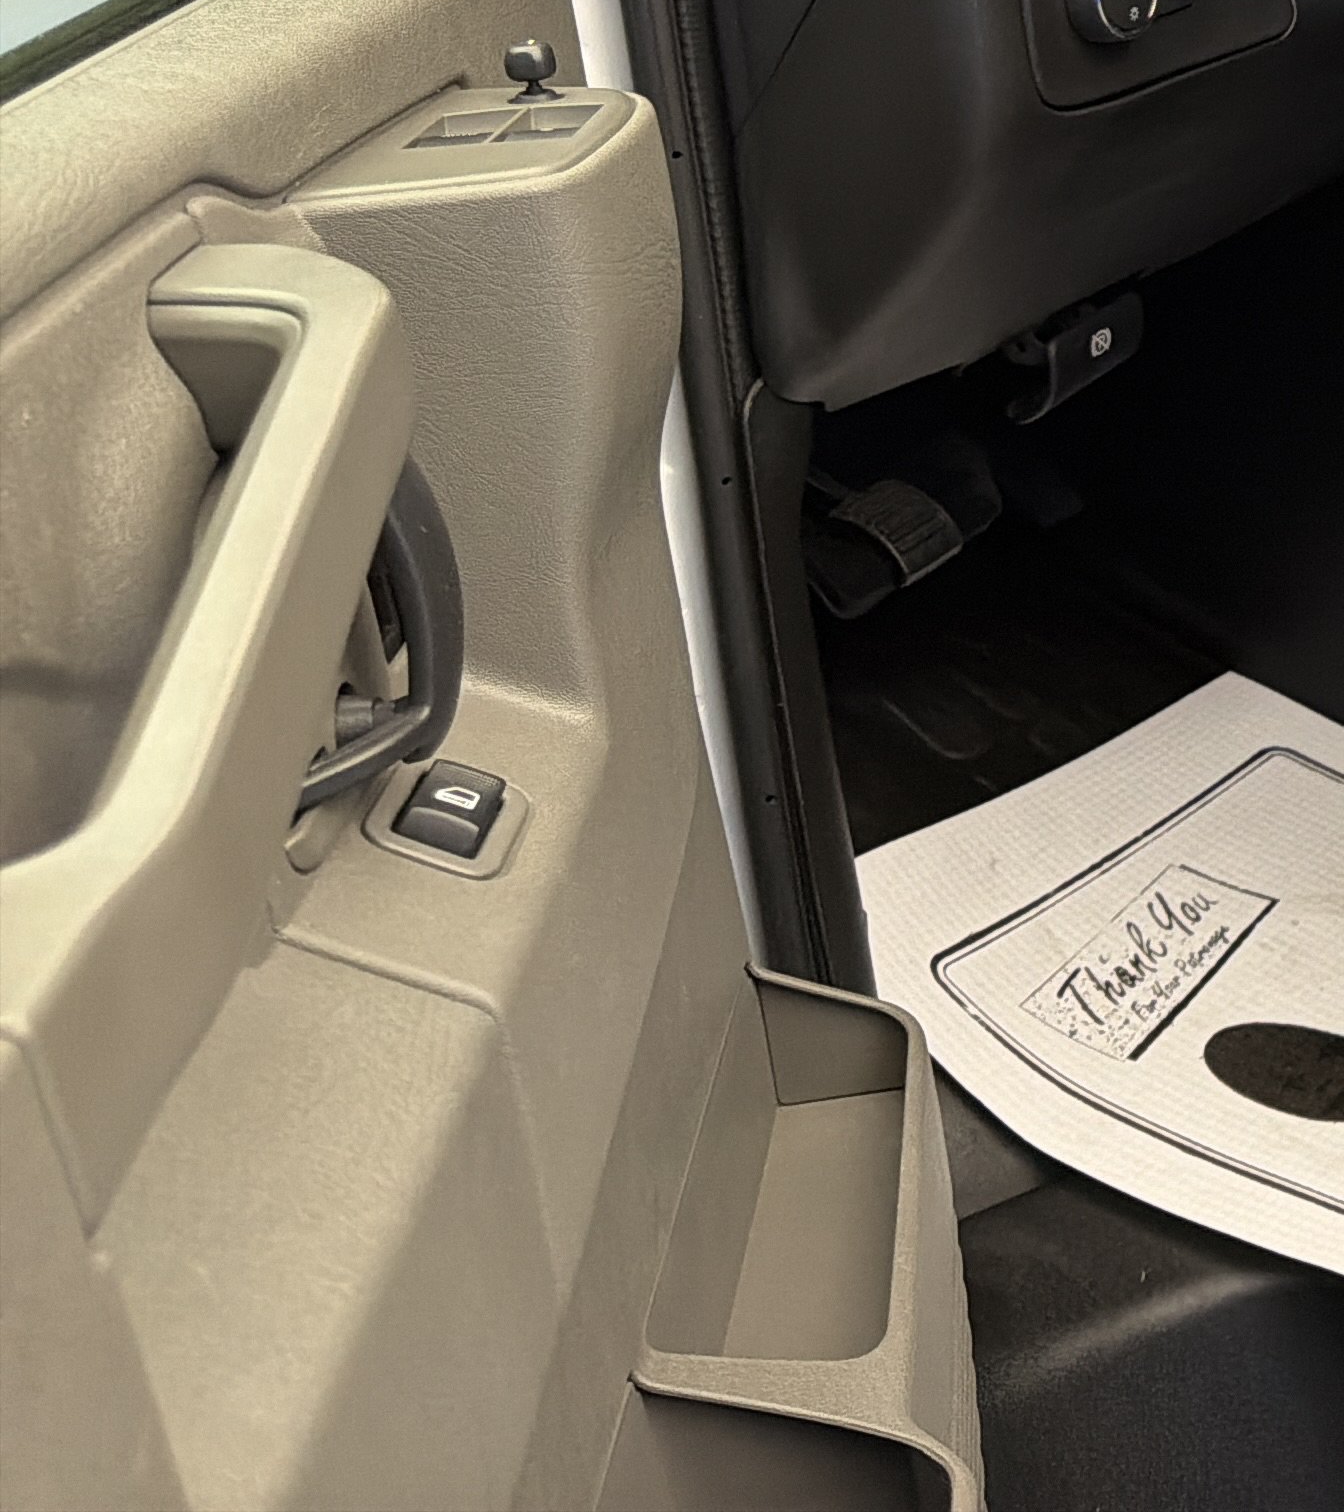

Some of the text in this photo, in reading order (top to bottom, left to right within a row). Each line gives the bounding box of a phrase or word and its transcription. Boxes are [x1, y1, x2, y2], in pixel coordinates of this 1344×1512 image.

[1057, 891, 1219, 1025] Thank You
[1131, 999, 1157, 1022] For
